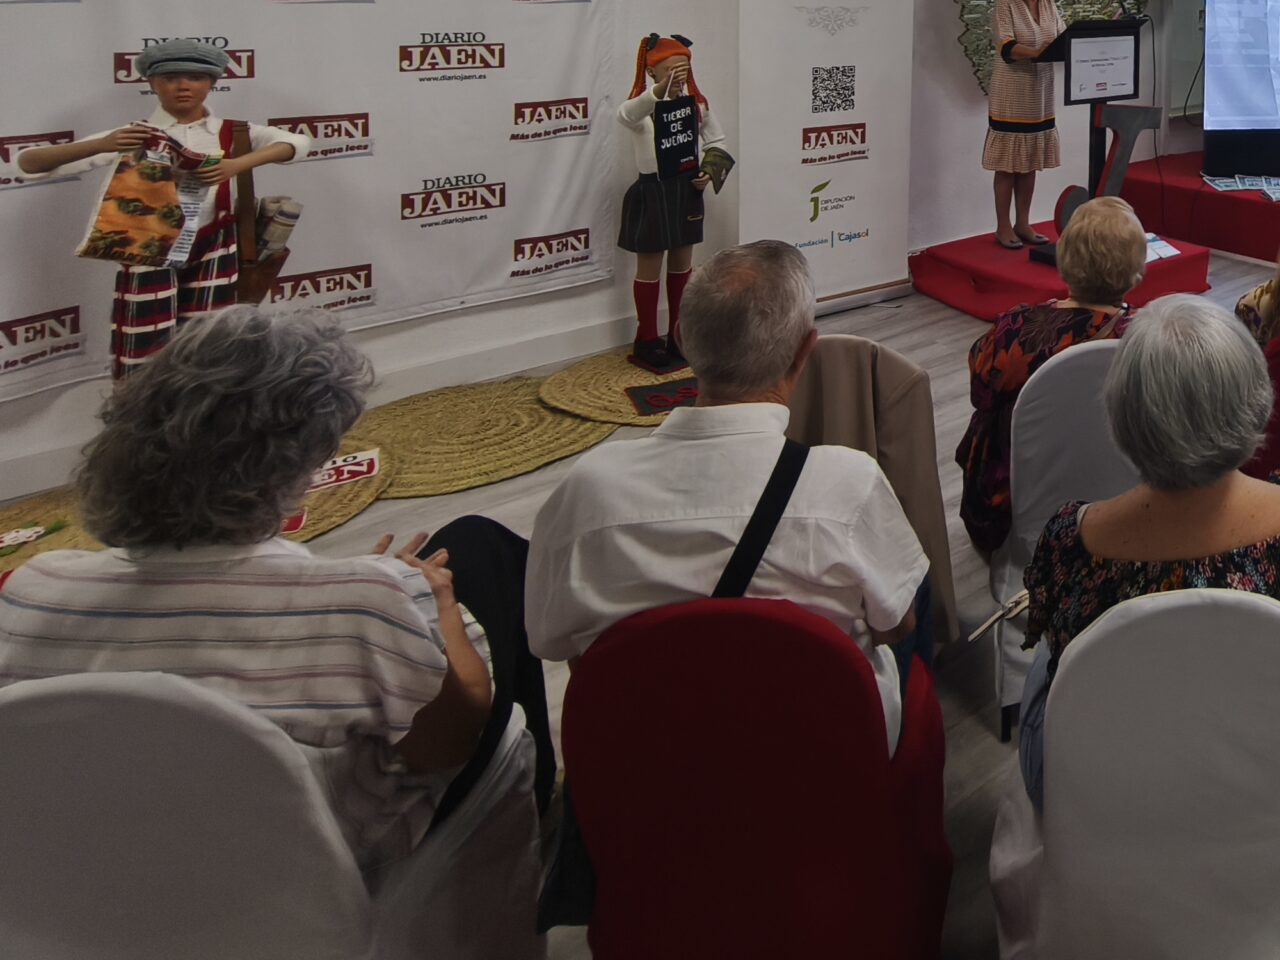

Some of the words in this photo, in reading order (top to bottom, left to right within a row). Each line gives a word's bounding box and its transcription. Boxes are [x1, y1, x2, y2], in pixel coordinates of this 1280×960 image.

[420, 32, 486, 44] DIARIO
[116, 52, 252, 81] JN
[401, 45, 503, 71] JAEN
[419, 73, 487, 83] www.diariojaen.es
[516, 103, 586, 125] JAEN
[662, 106, 692, 122] TIERRA
[670, 121, 683, 133] DE
[804, 129, 864, 150] JAEN
[320, 147, 344, 156] que
[345, 144, 369, 152] lees
[422, 173, 487, 190] DIARIO
[402, 184, 503, 218] JAEN
[420, 214, 488, 228] www.diariojaen.es
[838, 228, 869, 242] Cajasol
[516, 234, 587, 261] JAEN
[274, 271, 368, 302] JAEN
